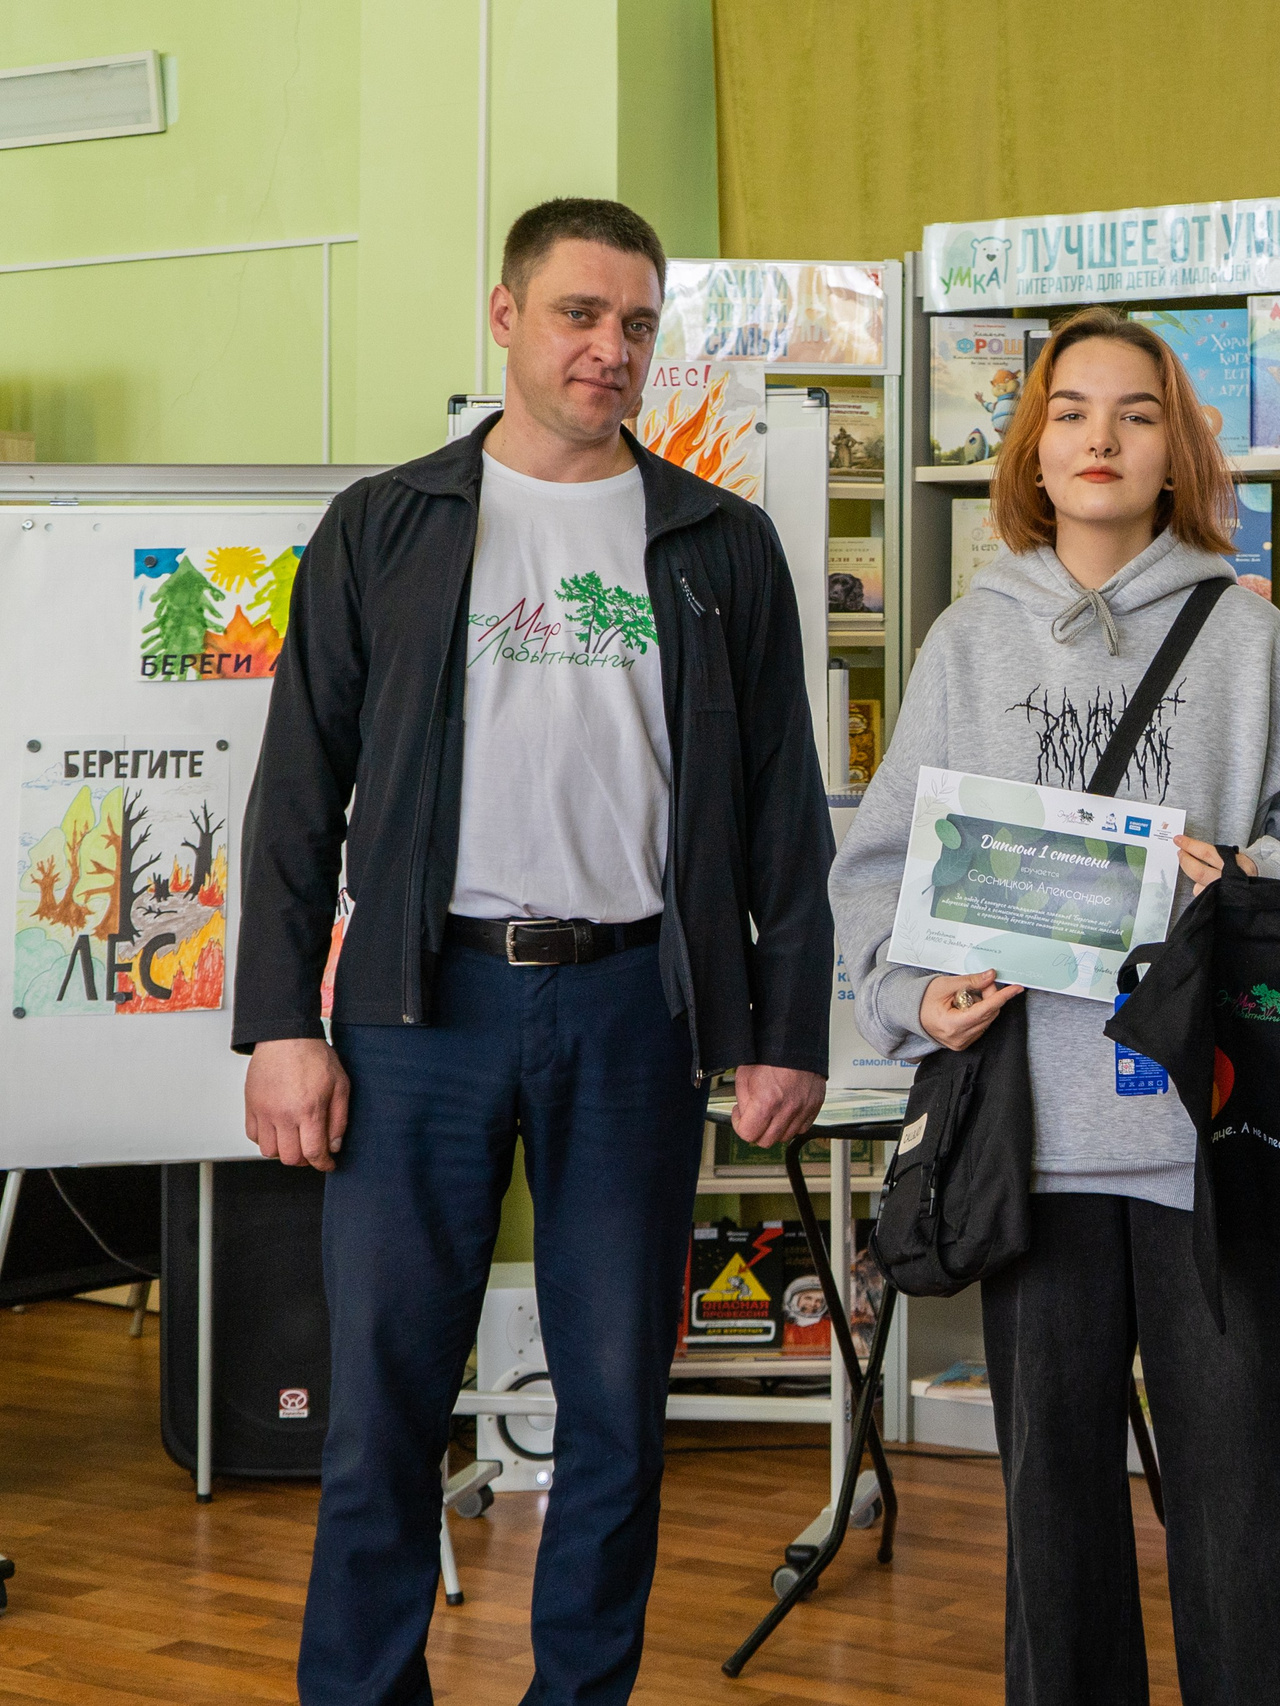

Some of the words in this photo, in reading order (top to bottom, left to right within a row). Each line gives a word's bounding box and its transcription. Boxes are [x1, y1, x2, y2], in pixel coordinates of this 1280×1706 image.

[1017, 218, 1158, 274] ЛУЧШЕЕ
[1171, 214, 1211, 263] ОТ
[940, 266, 1001, 294] УМКА
[1017, 274, 1093, 296] ЛИТЕРАТУРА
[1097, 273, 1123, 292] ДЛЯ
[1127, 267, 1166, 290] ДЕТЕЙ
[1170, 272, 1179, 286] И
[652, 364, 712, 389] ЛЕС!
[467, 626, 636, 671] Лабытнанги
[141, 653, 252, 676] БЕРЕГИ
[64, 750, 204, 778] БЕРЕГИТЕ
[980, 833, 1037, 858] Диплом
[1038, 844, 1048, 859] 1
[1049, 850, 1111, 870] степени
[1020, 865, 1060, 879] вручается
[966, 868, 1034, 894] Сосницкой
[1036, 881, 1112, 908] Александре
[56, 932, 176, 1002] ЛЕС
[1241, 1122, 1250, 1134] А
[1252, 1127, 1262, 1138] не
